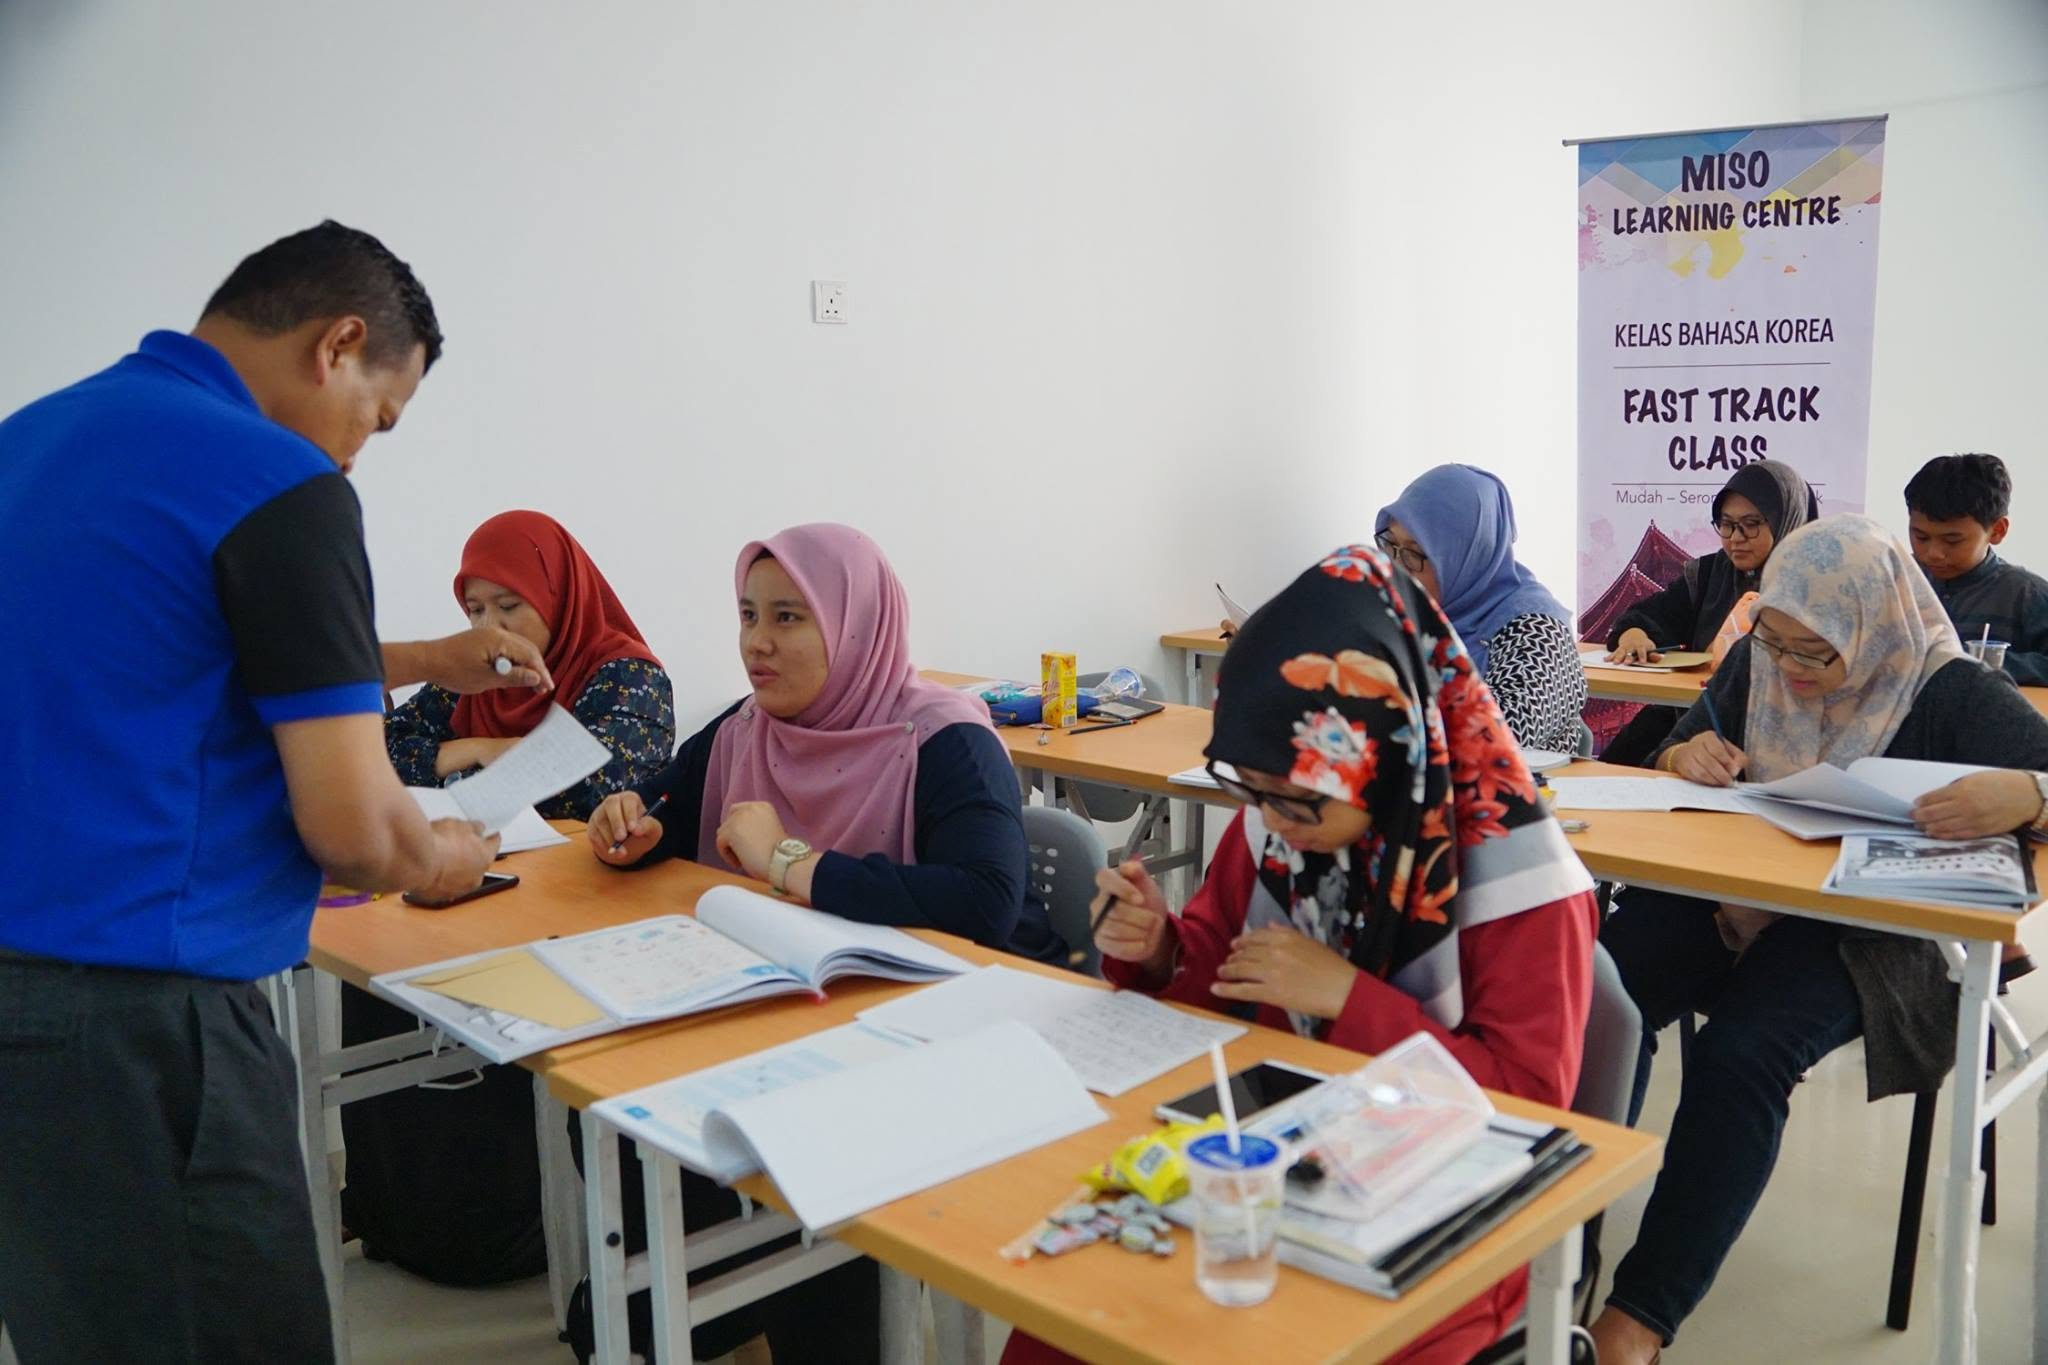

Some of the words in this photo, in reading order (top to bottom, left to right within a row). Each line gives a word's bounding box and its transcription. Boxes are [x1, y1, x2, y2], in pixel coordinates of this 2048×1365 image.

[1681, 150, 1770, 193] MISO
[1613, 203, 1736, 235] LEARNING
[1743, 195, 1842, 228] CENTRE
[1615, 322, 1672, 348] KELAS
[1678, 320, 1760, 346] BAHASA
[1765, 318, 1834, 344] KOREA
[1624, 388, 1700, 424] FAST
[1708, 386, 1820, 423] TRACK
[1668, 435, 1767, 471] CLASS
[1616, 489, 1663, 504] Mudah
